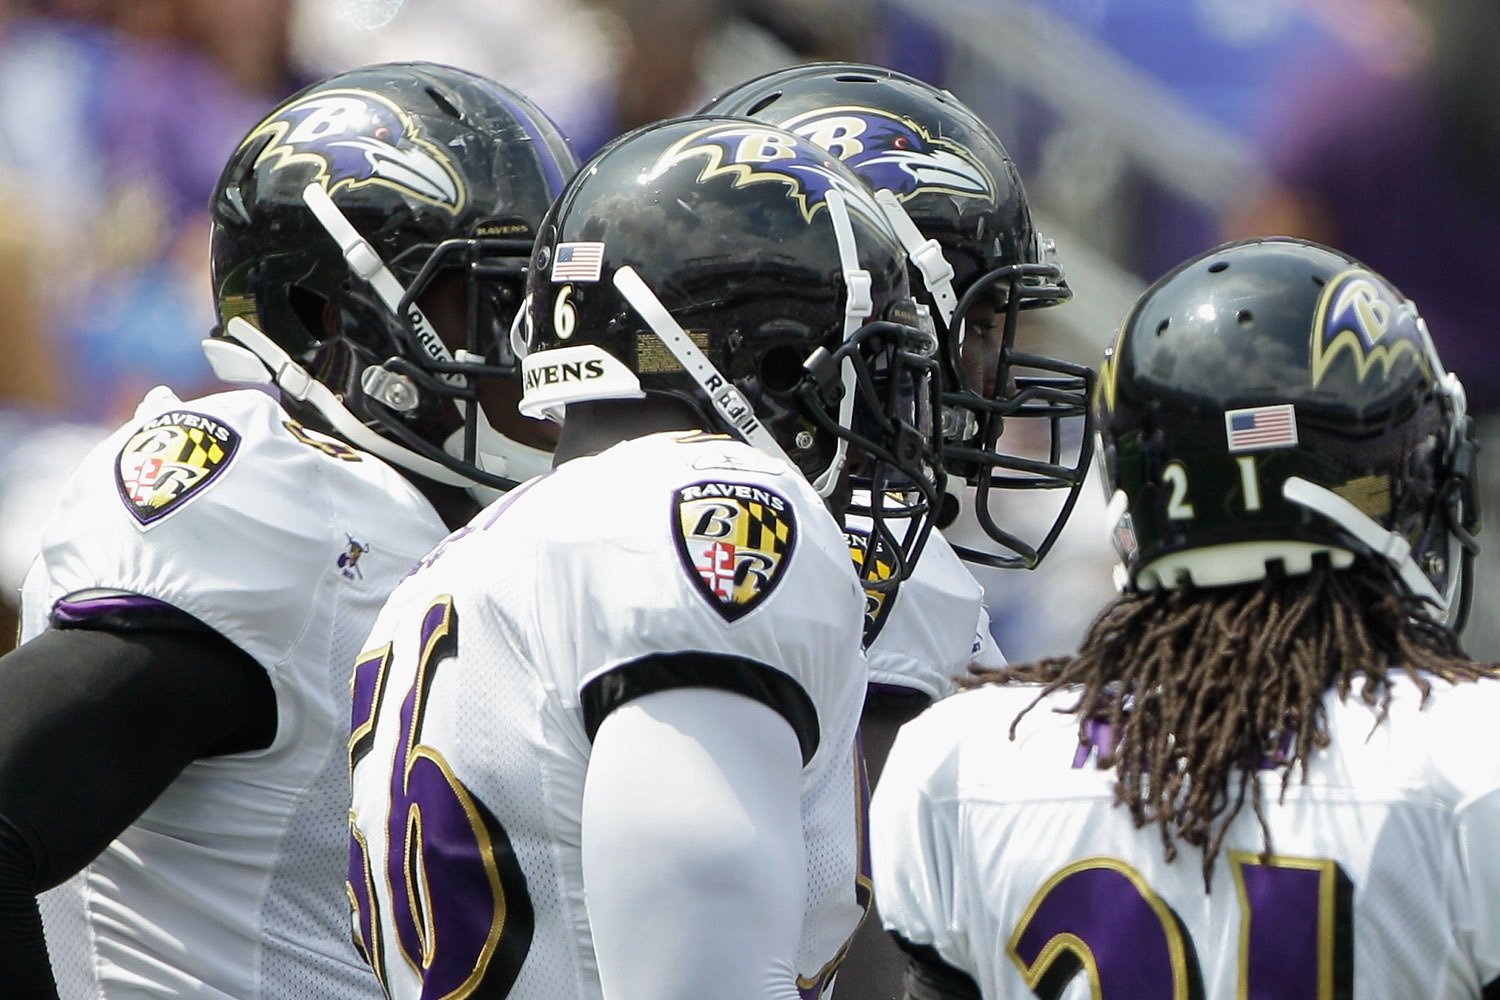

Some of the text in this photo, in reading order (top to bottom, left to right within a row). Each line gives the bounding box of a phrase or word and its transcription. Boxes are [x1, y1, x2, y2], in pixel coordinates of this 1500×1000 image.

[475, 225, 529, 236] RAVENS
[525, 359, 604, 391] AVENS
[142, 413, 231, 442] RAVENS
[680, 483, 785, 512] RAVENS
